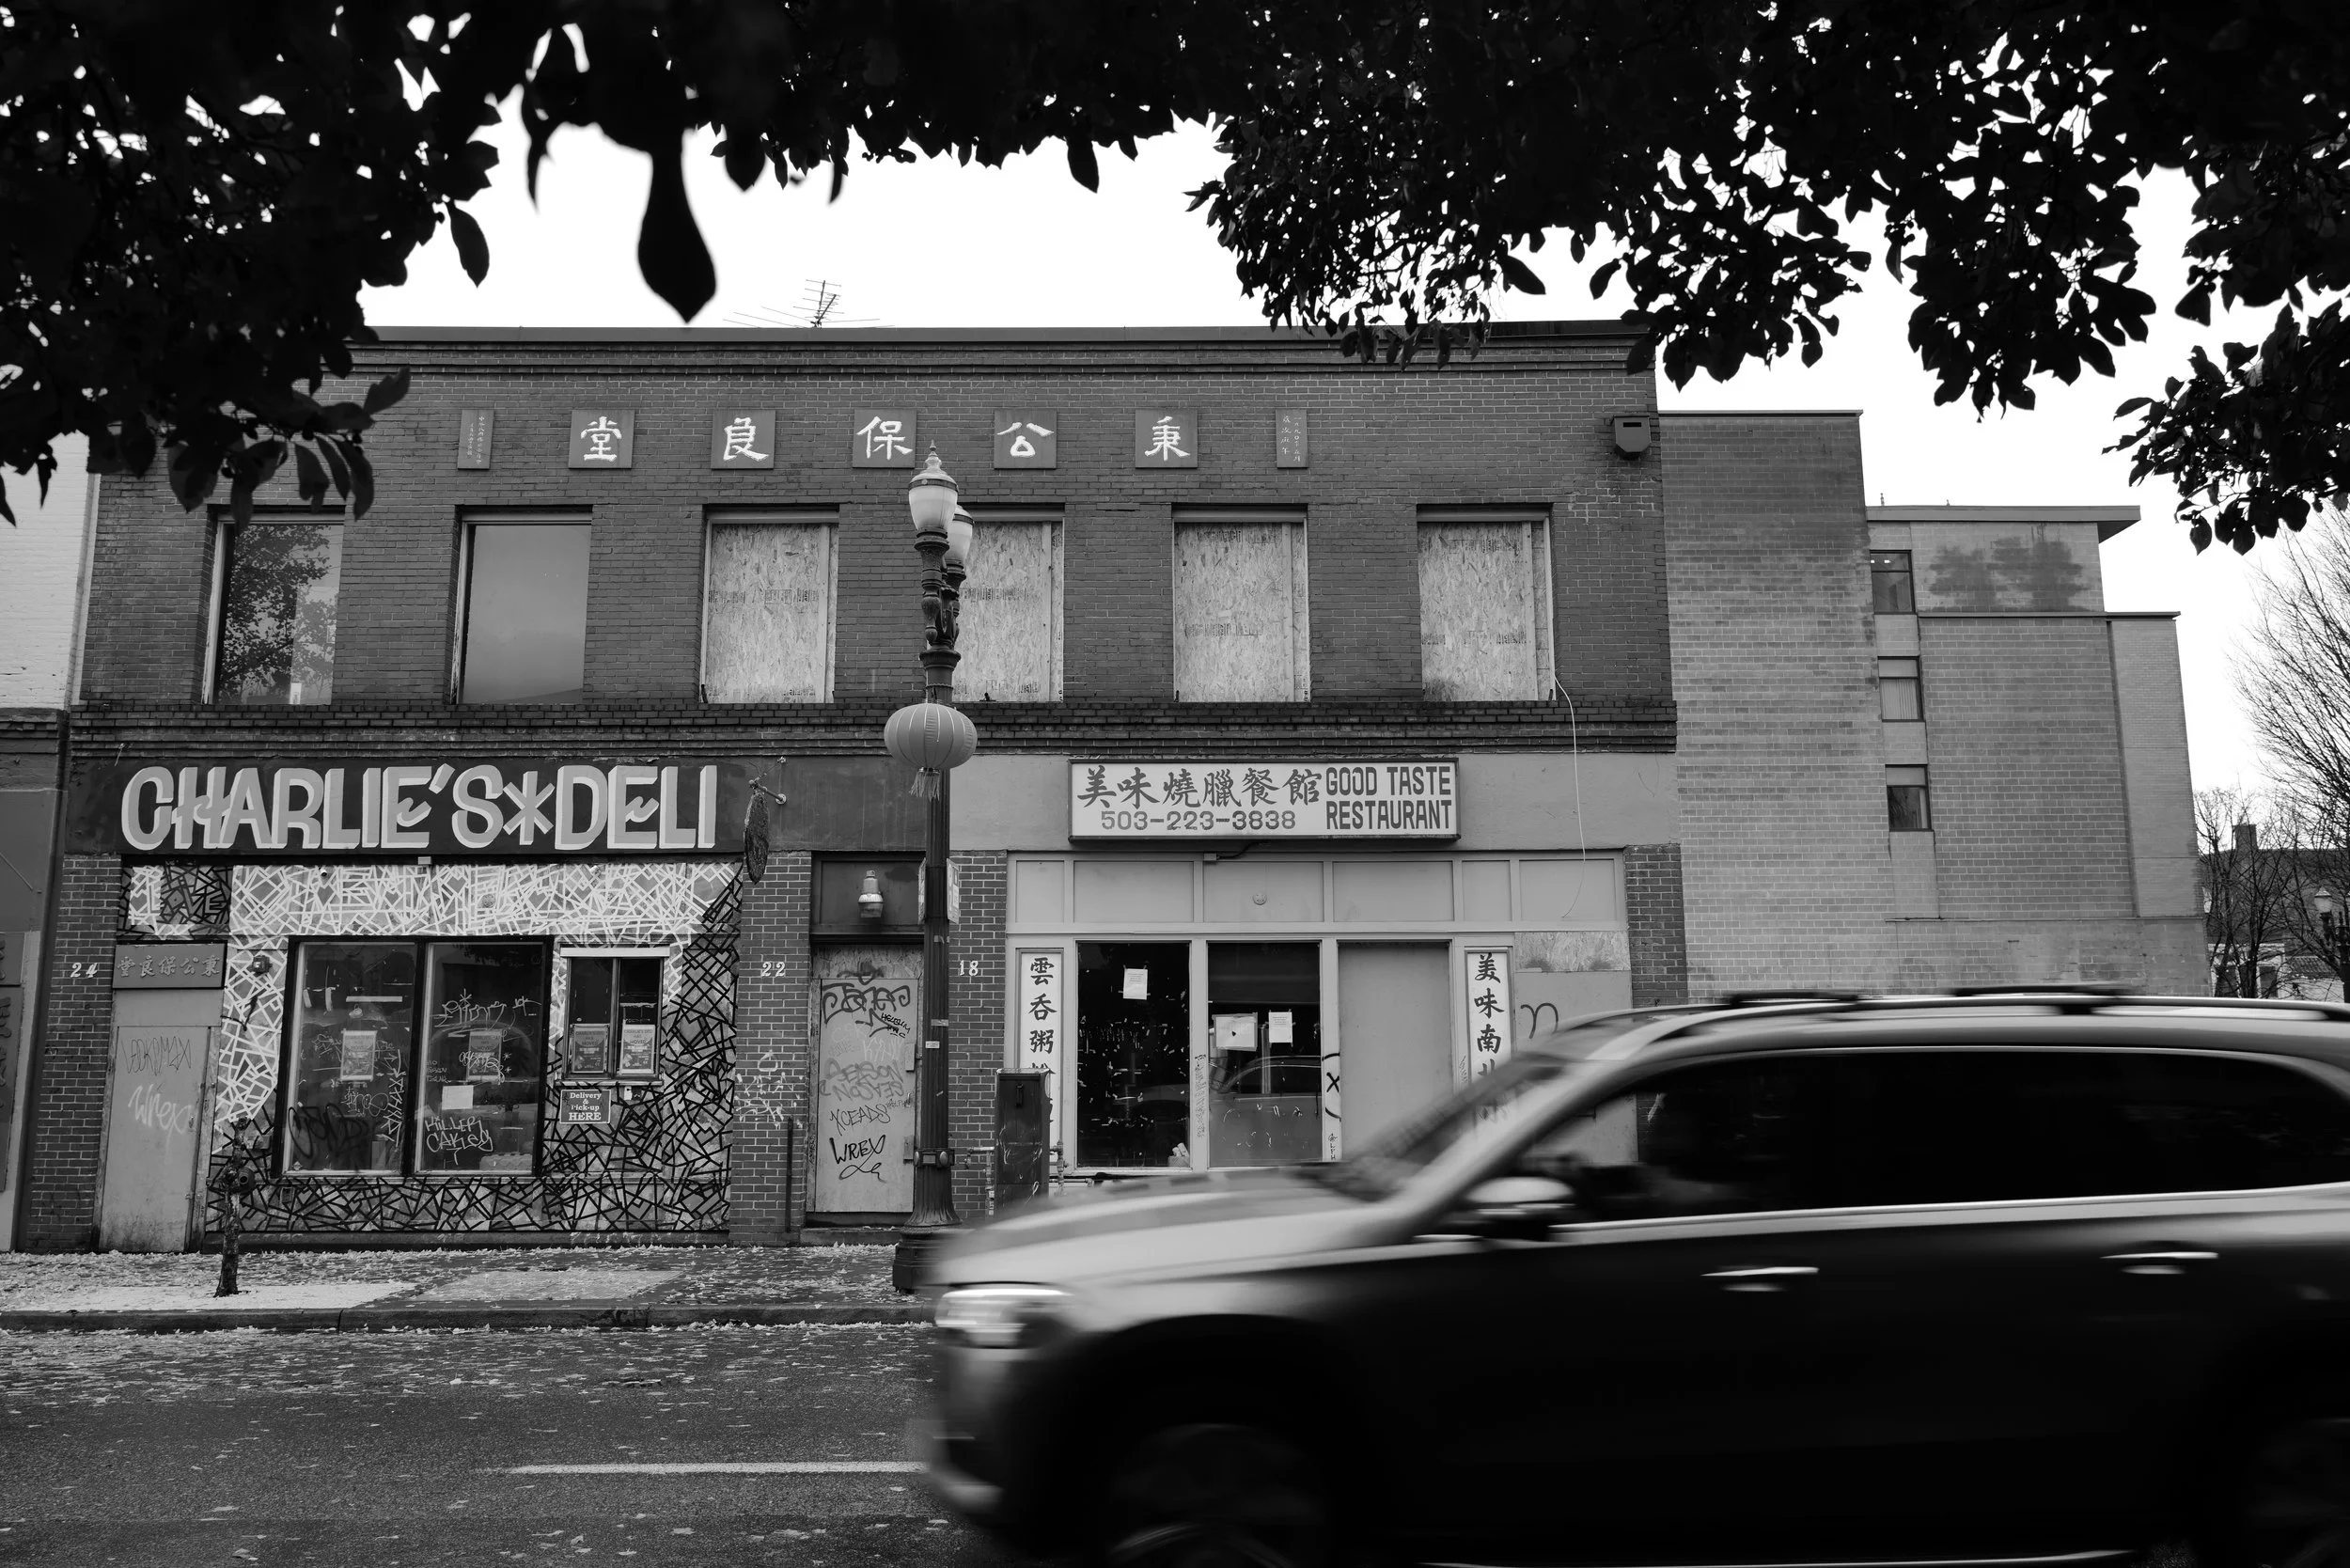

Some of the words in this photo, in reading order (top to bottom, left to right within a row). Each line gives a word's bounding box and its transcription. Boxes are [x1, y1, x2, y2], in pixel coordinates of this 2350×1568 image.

[1325, 766, 1378, 796] GOOD
[1386, 766, 1451, 796] TASTE
[121, 763, 504, 851] CHARLIE'S
[555, 764, 718, 851] DELI
[1325, 799, 1453, 830] RESTAURANT
[1100, 809, 1297, 831] 503-223-3838
[70, 961, 99, 979] 24
[760, 961, 787, 978] 22
[959, 959, 979, 977] 18
[570, 1091, 603, 1100] Delivery
[568, 1111, 602, 1121] HERE
